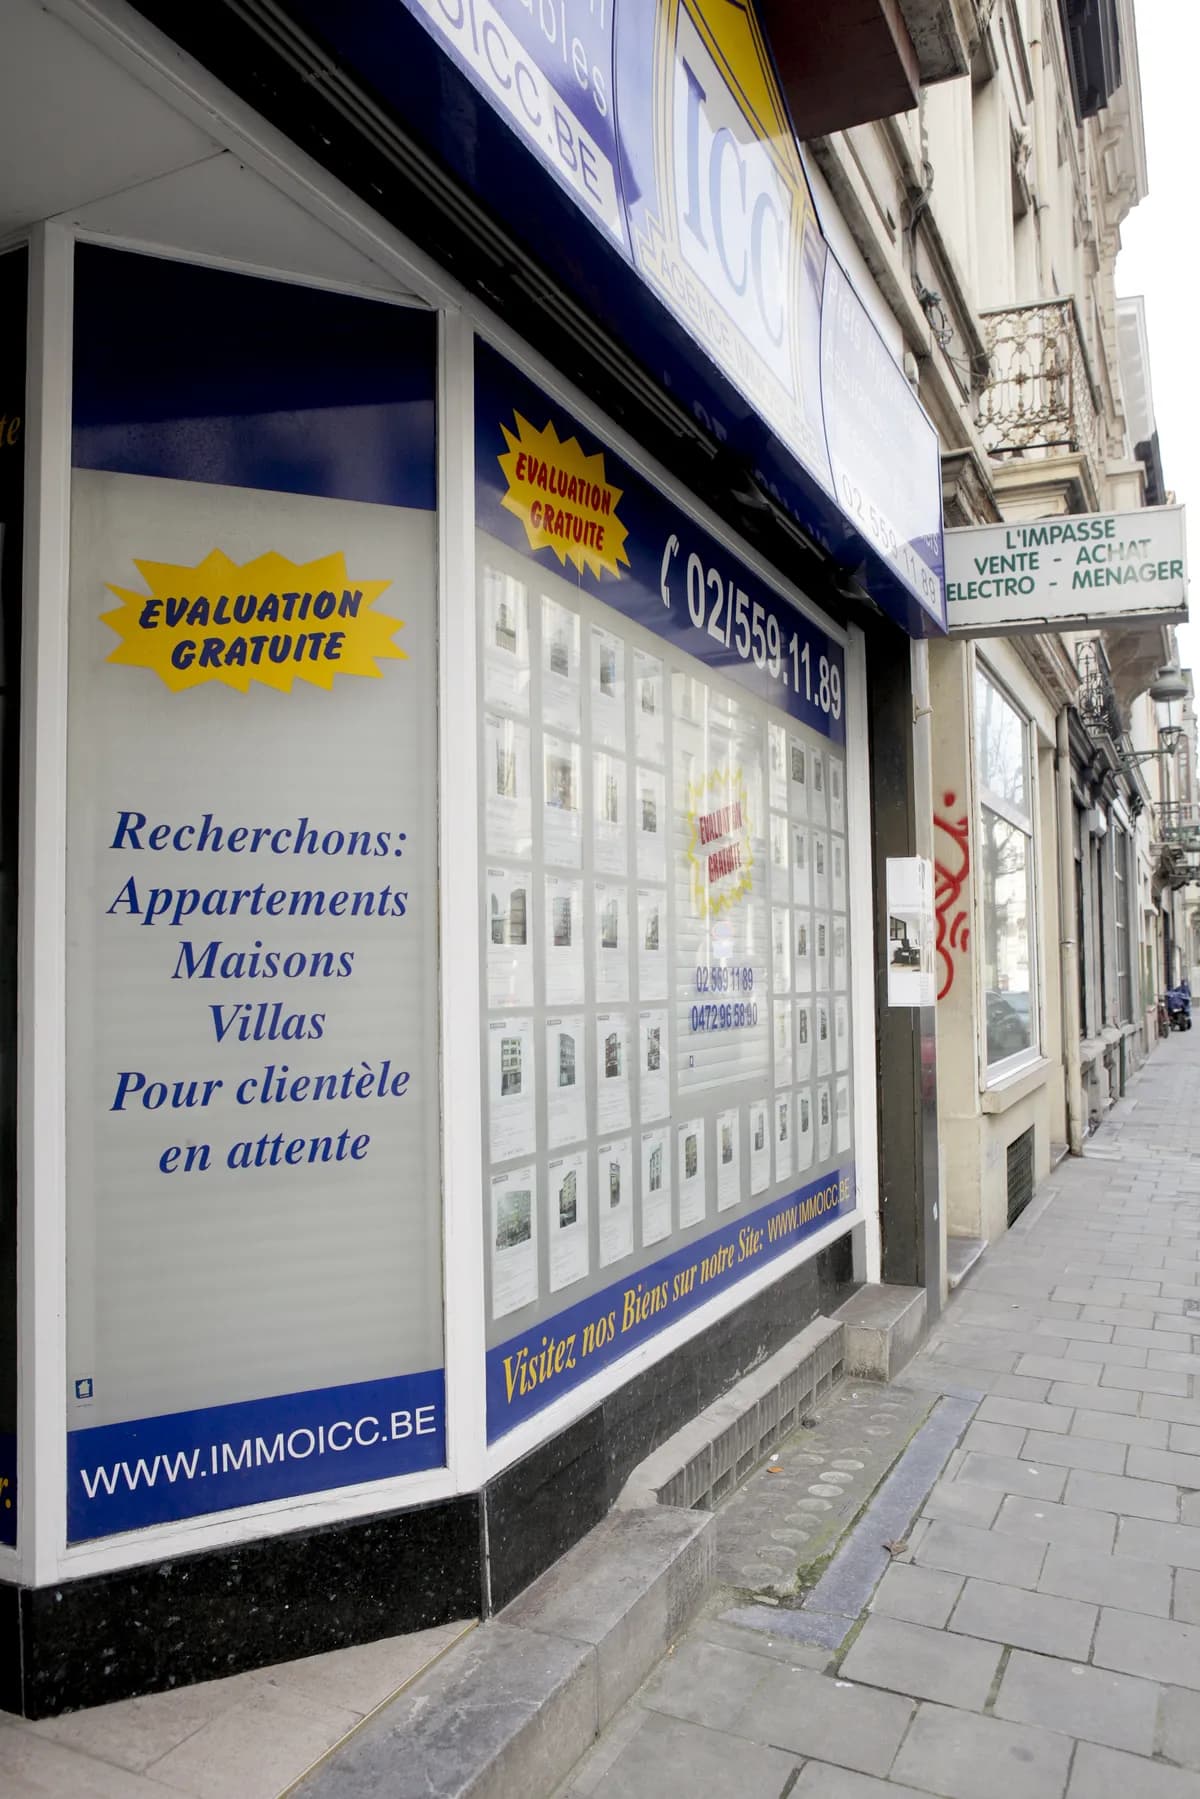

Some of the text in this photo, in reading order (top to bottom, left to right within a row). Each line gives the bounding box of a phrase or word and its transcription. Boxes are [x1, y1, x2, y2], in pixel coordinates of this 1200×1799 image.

[683, 55, 786, 347] ICC
[515, 452, 612, 516] EVALUATION
[530, 500, 605, 551] GRATUITE
[842, 474, 865, 521] 02
[869, 505, 898, 559] 559
[903, 547, 917, 584] 11
[920, 567, 936, 604] 89
[1006, 519, 1116, 550] L'IMPASSE
[947, 576, 1036, 602] ELECTRO
[1072, 559, 1184, 590] MENAGER
[974, 552, 1040, 576] VENTE
[1076, 538, 1152, 565] ACHAT
[139, 589, 363, 629] EVALUATION
[170, 632, 347, 671] GRATUITE
[686, 552, 842, 719] 02/559.11.89
[108, 811, 407, 857] Recherchons:
[106, 875, 408, 926] Appartements
[171, 940, 355, 980] Maisons
[208, 1002, 326, 1043] Villas
[109, 1060, 411, 1112] Pour clientèle
[159, 1128, 371, 1174] en attente
[503, 1335, 576, 1405] Visitez
[582, 1311, 616, 1354] nos
[621, 1283, 668, 1333] Biens
[672, 1270, 697, 1301] sur
[700, 1245, 734, 1284] notre
[738, 1226, 764, 1263] Site:
[767, 1176, 852, 1243] WWW.IMMOICC.BE
[80, 1405, 437, 1498] WWW.IMMOICC.BE
